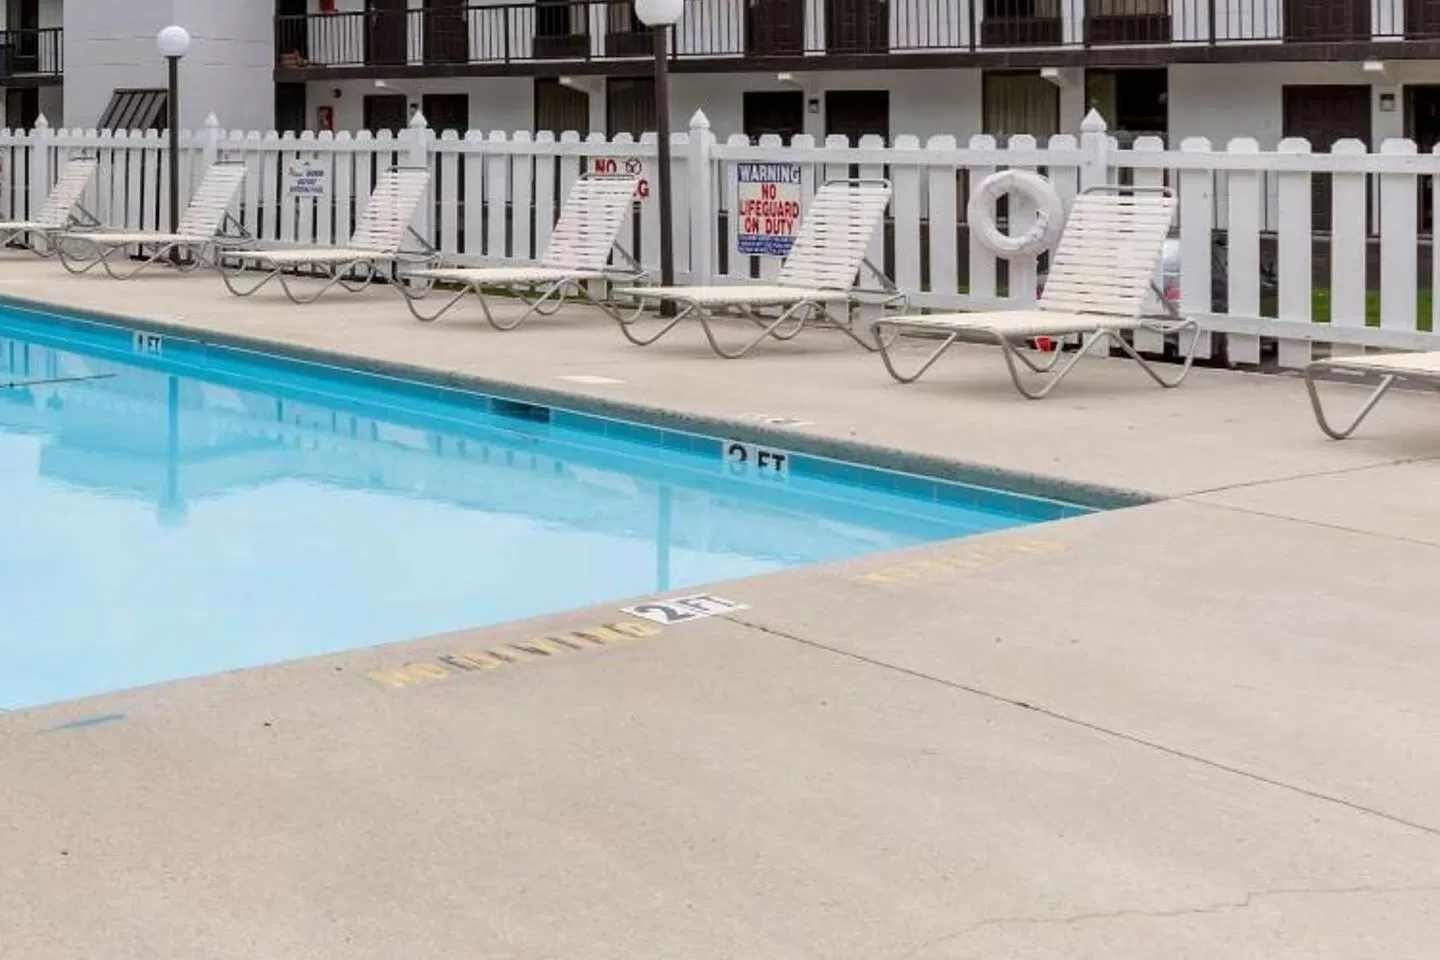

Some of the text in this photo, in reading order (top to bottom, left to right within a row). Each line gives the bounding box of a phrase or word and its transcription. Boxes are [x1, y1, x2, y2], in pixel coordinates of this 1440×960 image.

[594, 158, 617, 173] NO
[739, 164, 800, 182] WARNING
[762, 184, 777, 200] NO
[739, 200, 800, 218] LIFEGUARD
[744, 217, 793, 235] ON DUTY
[758, 451, 786, 471] FT
